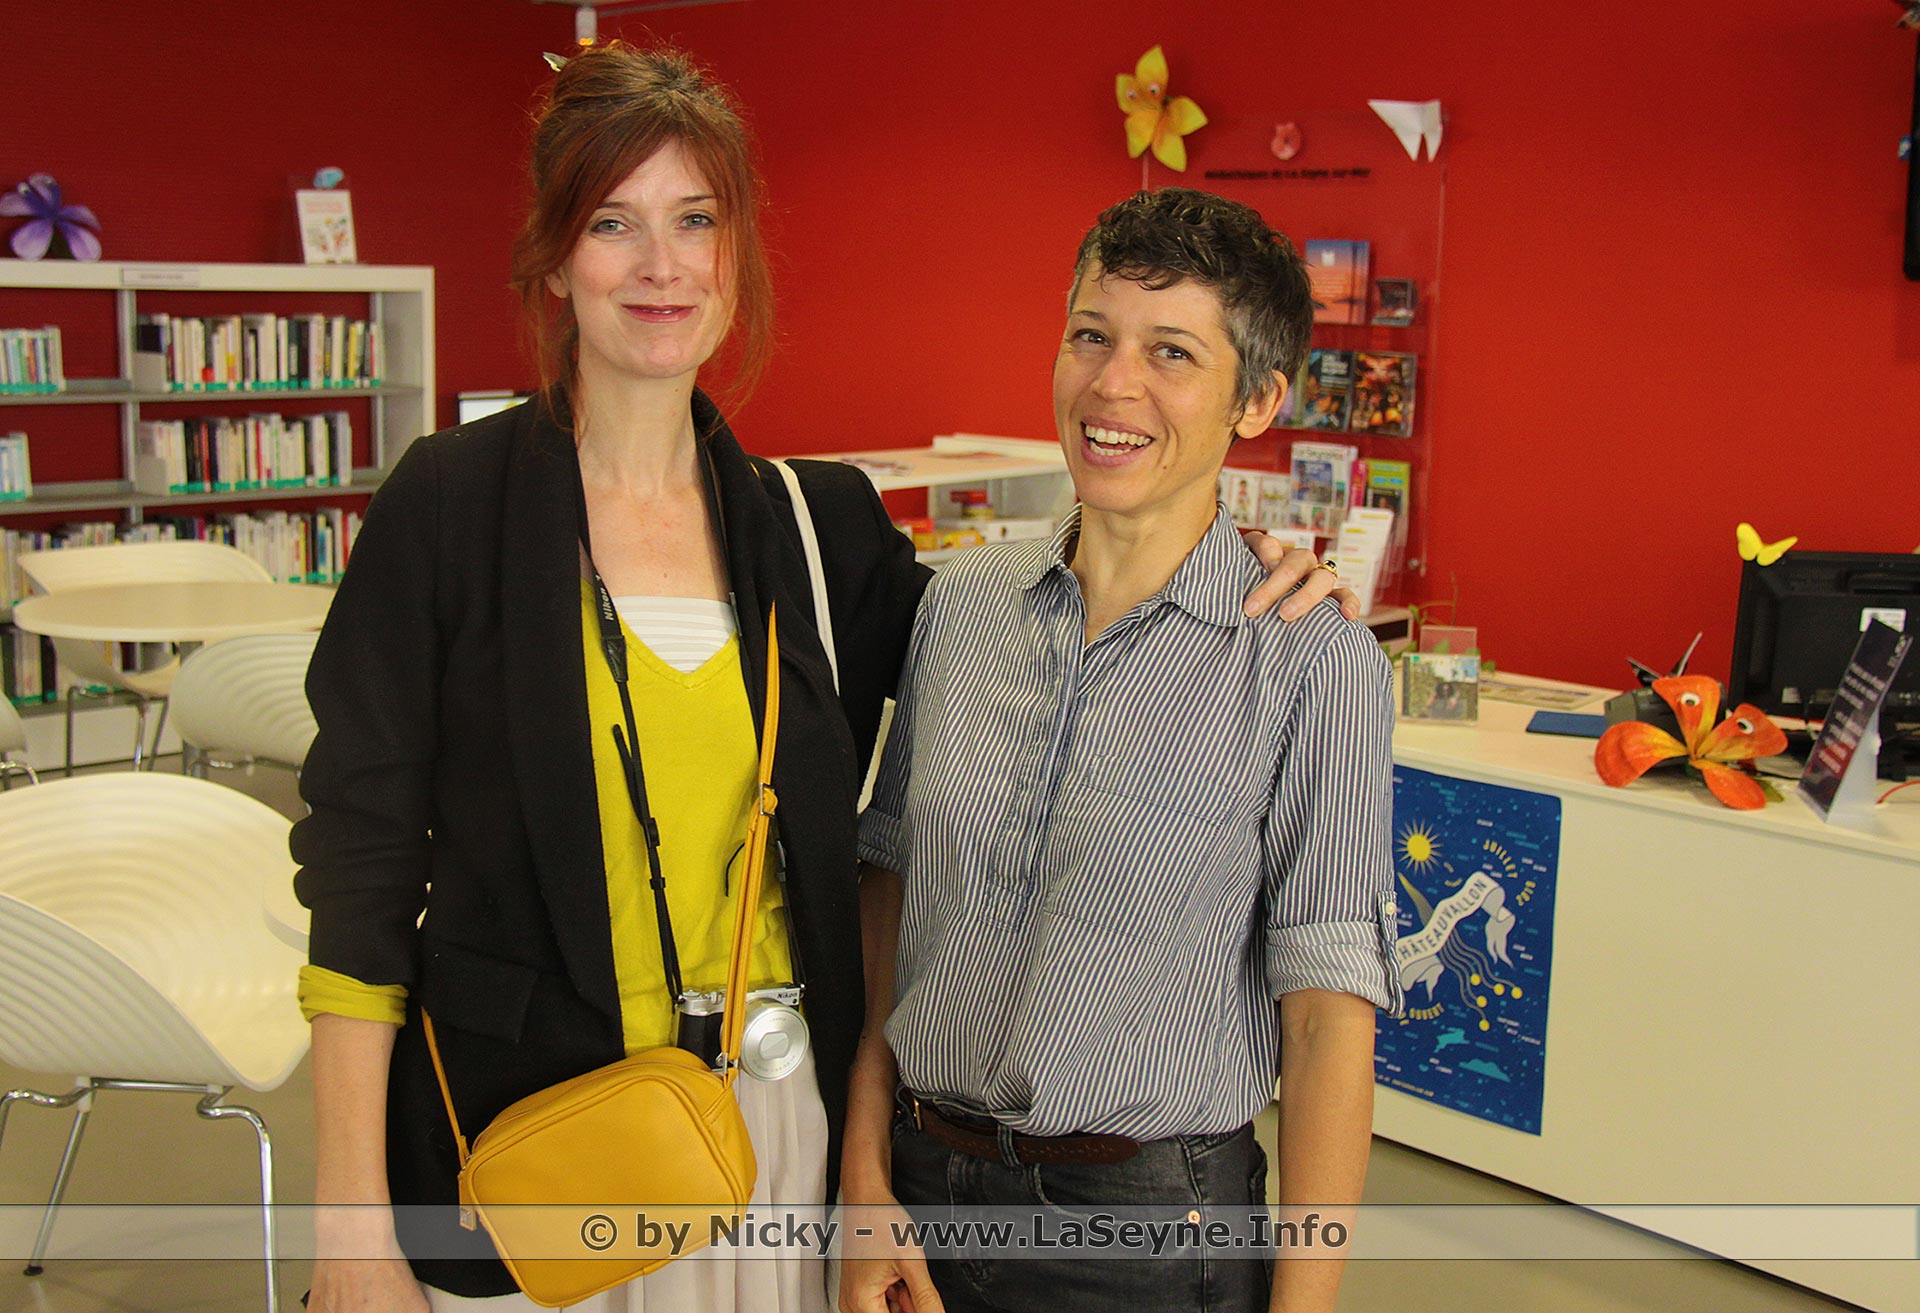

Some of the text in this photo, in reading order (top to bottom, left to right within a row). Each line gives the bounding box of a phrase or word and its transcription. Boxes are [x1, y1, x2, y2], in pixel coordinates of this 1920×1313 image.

[600, 587, 614, 620] Nikon
[1483, 839, 1518, 878] JUILLET
[1398, 879, 1487, 961] HÂTEAUVALLON
